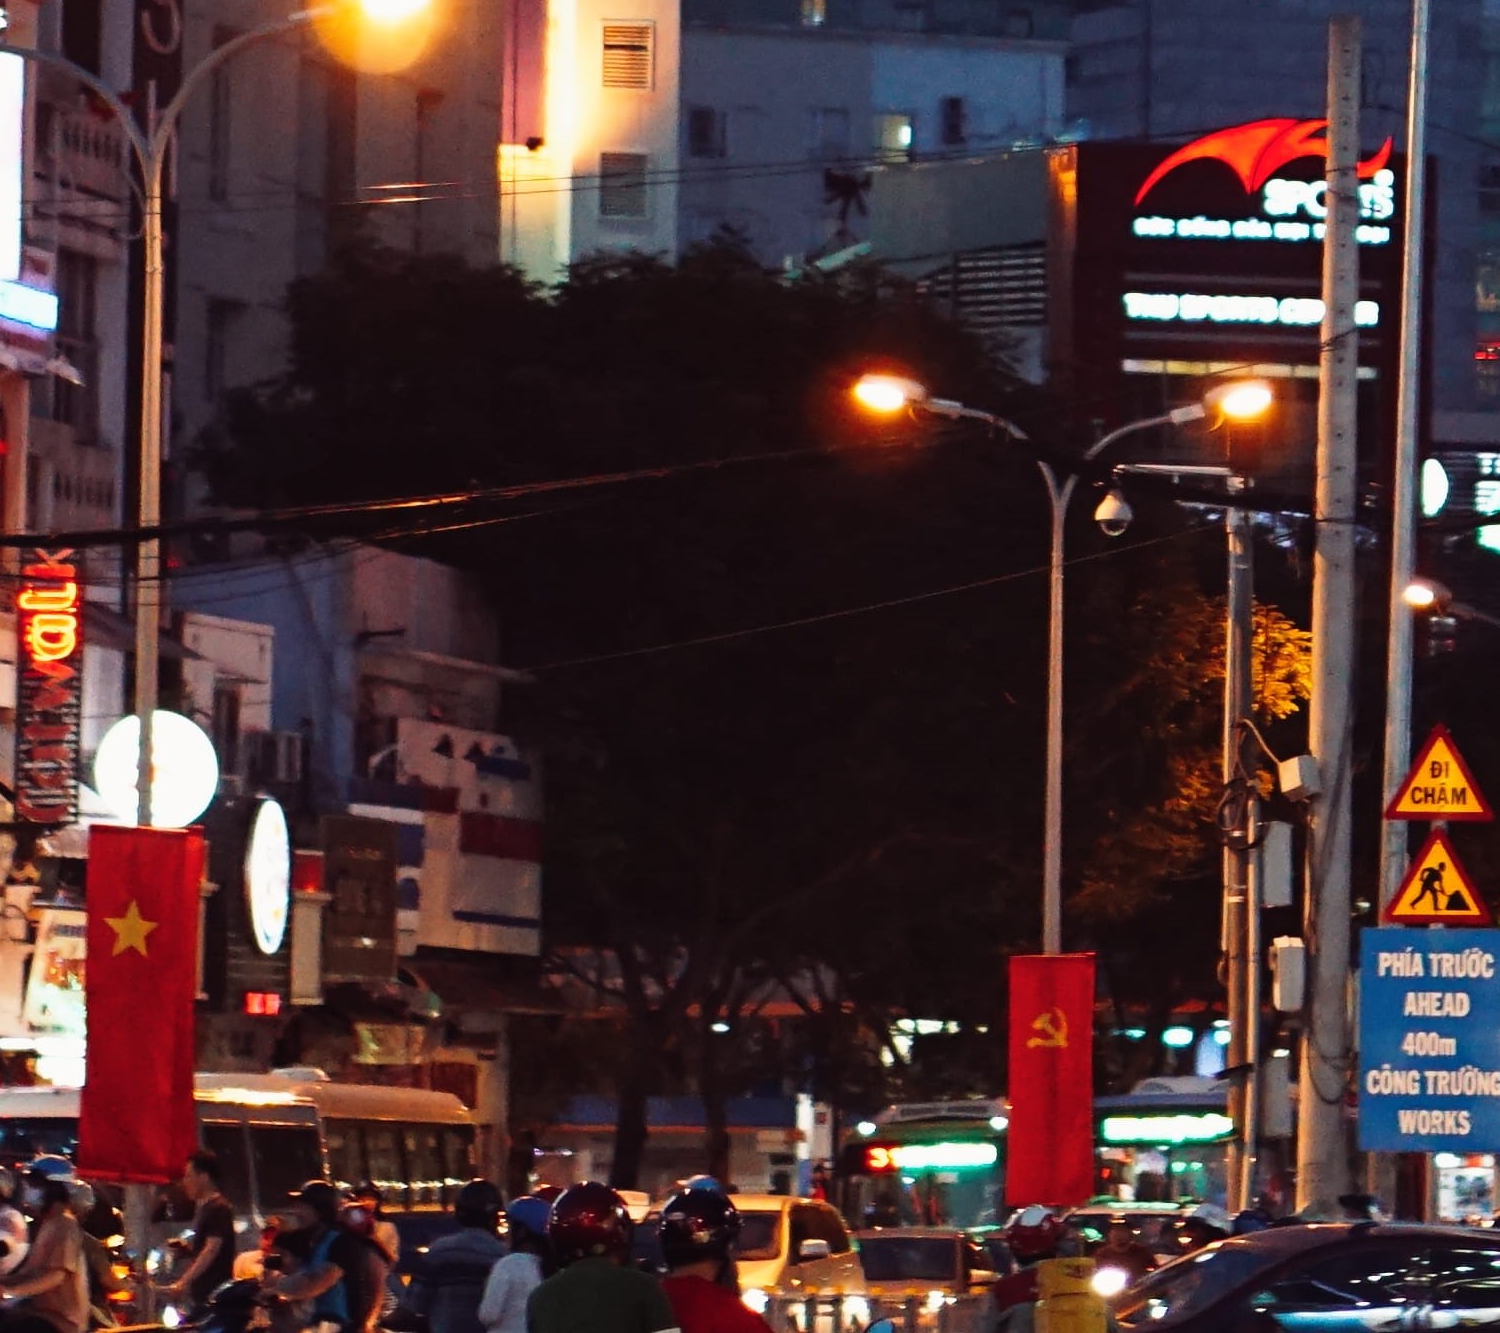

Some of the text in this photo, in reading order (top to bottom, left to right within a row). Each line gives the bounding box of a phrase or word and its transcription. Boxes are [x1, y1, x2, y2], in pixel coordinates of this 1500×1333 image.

[1429, 760, 1450, 780] ĐI
[1378, 946, 1494, 979] PHÍA TRƯỚC
[1404, 992, 1470, 1018] AHEAD
[1402, 1032, 1457, 1057] 400m
[1366, 1062, 1421, 1096] CÔNG
[1398, 1109, 1472, 1136] WORKS
